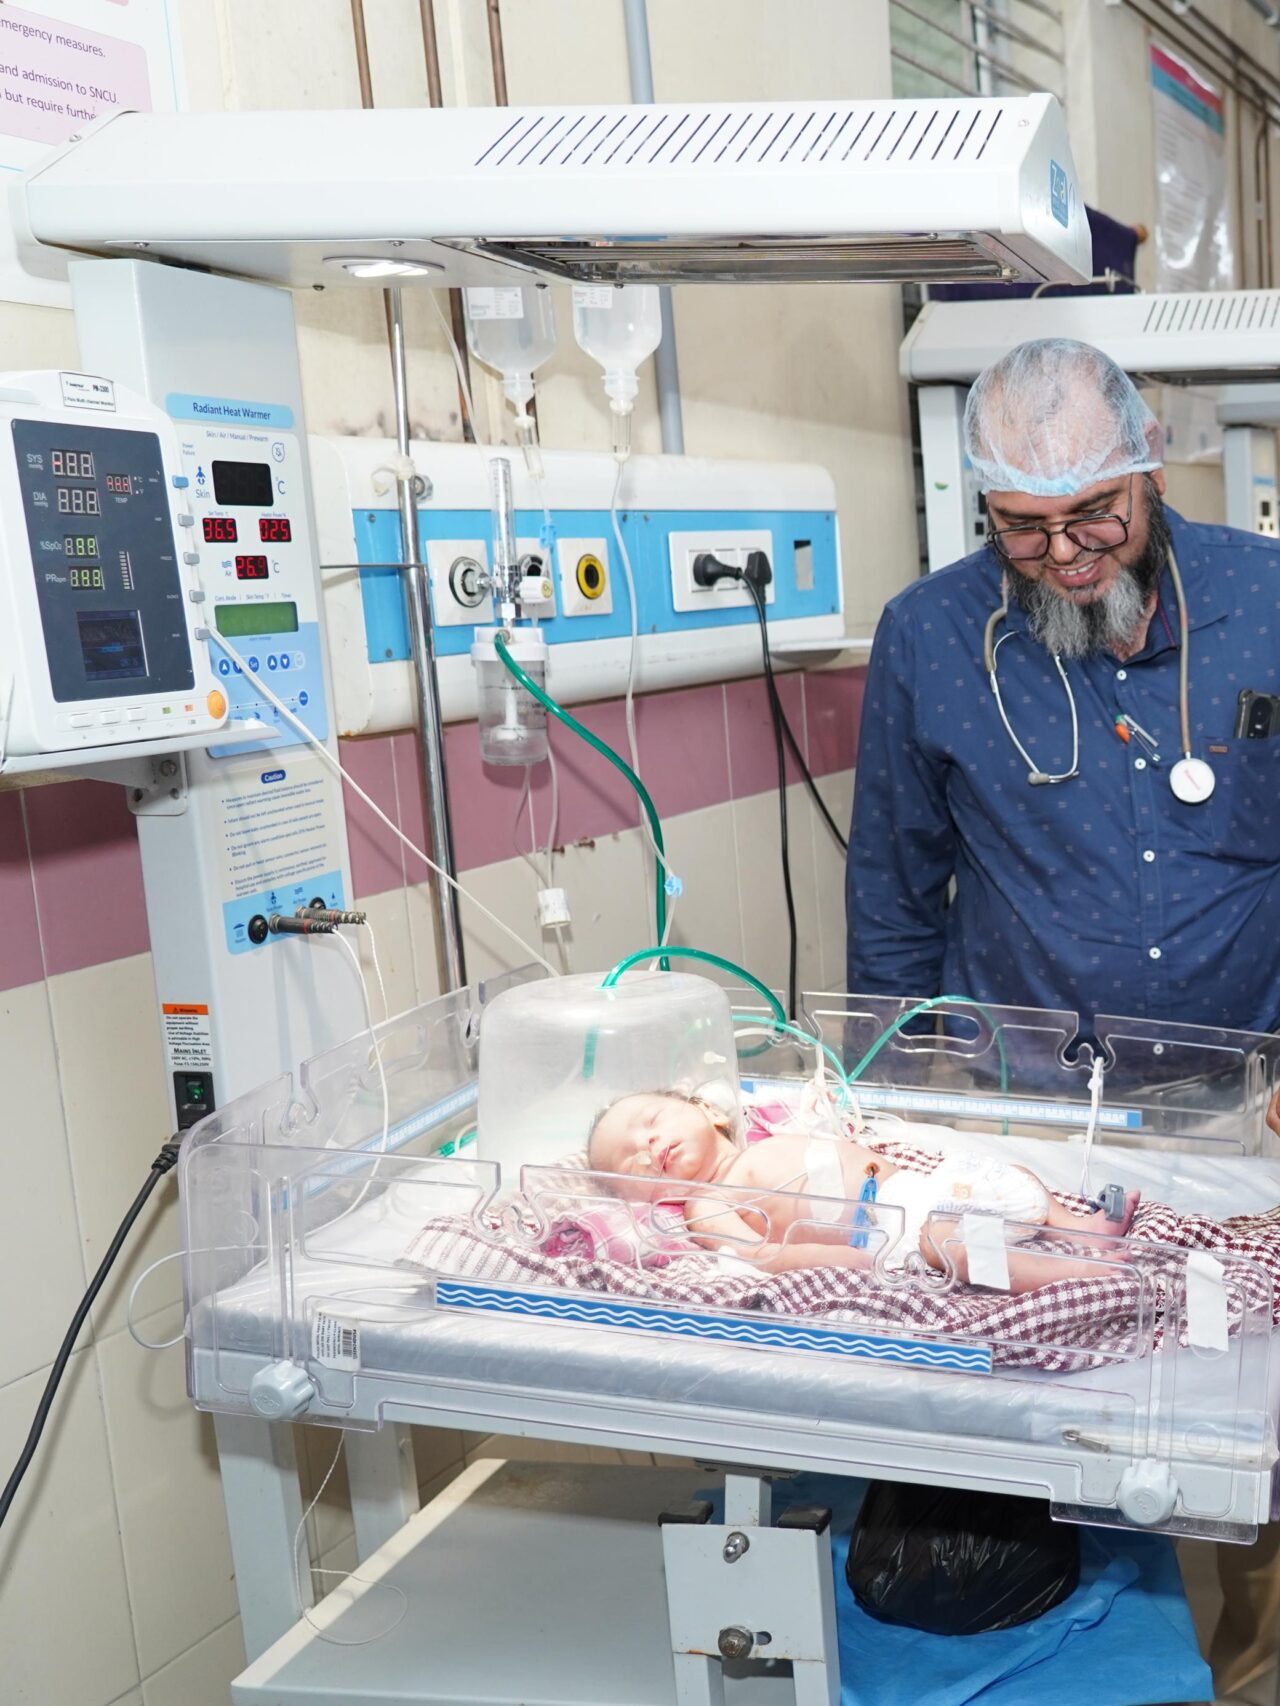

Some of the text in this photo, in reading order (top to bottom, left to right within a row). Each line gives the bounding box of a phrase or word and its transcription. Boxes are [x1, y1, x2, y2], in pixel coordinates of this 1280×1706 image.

[0, 18, 107, 58] mergency measures.
[0, 63, 120, 104] and admission to SNCU.
[5, 87, 98, 121] but require furthe
[192, 402, 272, 420] Radiant Heat Warmer
[206, 430, 217, 438] Skin
[230, 433, 246, 441] Manual
[26, 453, 44, 464] SYS
[33, 491, 48, 501] DIA
[195, 489, 211, 499] Skin
[260, 520, 289, 540] 025
